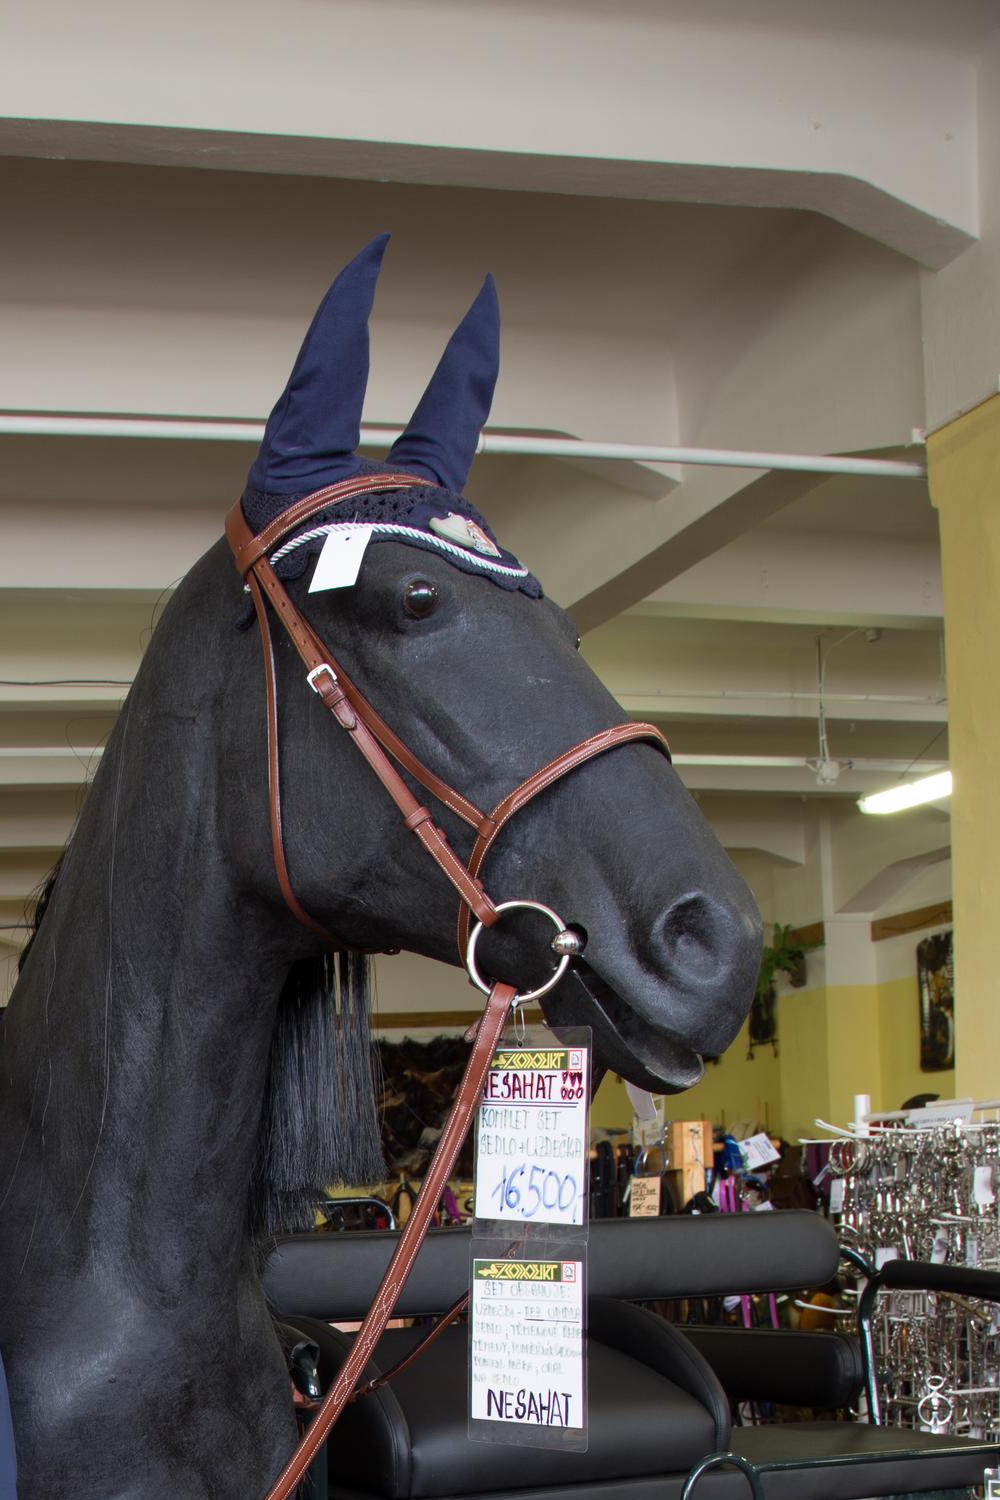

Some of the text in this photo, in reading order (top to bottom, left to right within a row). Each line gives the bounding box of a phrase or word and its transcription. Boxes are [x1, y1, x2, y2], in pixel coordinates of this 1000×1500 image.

[481, 1107, 563, 1130] KOMPLET SET
[487, 1388, 572, 1427] NESAHAT
